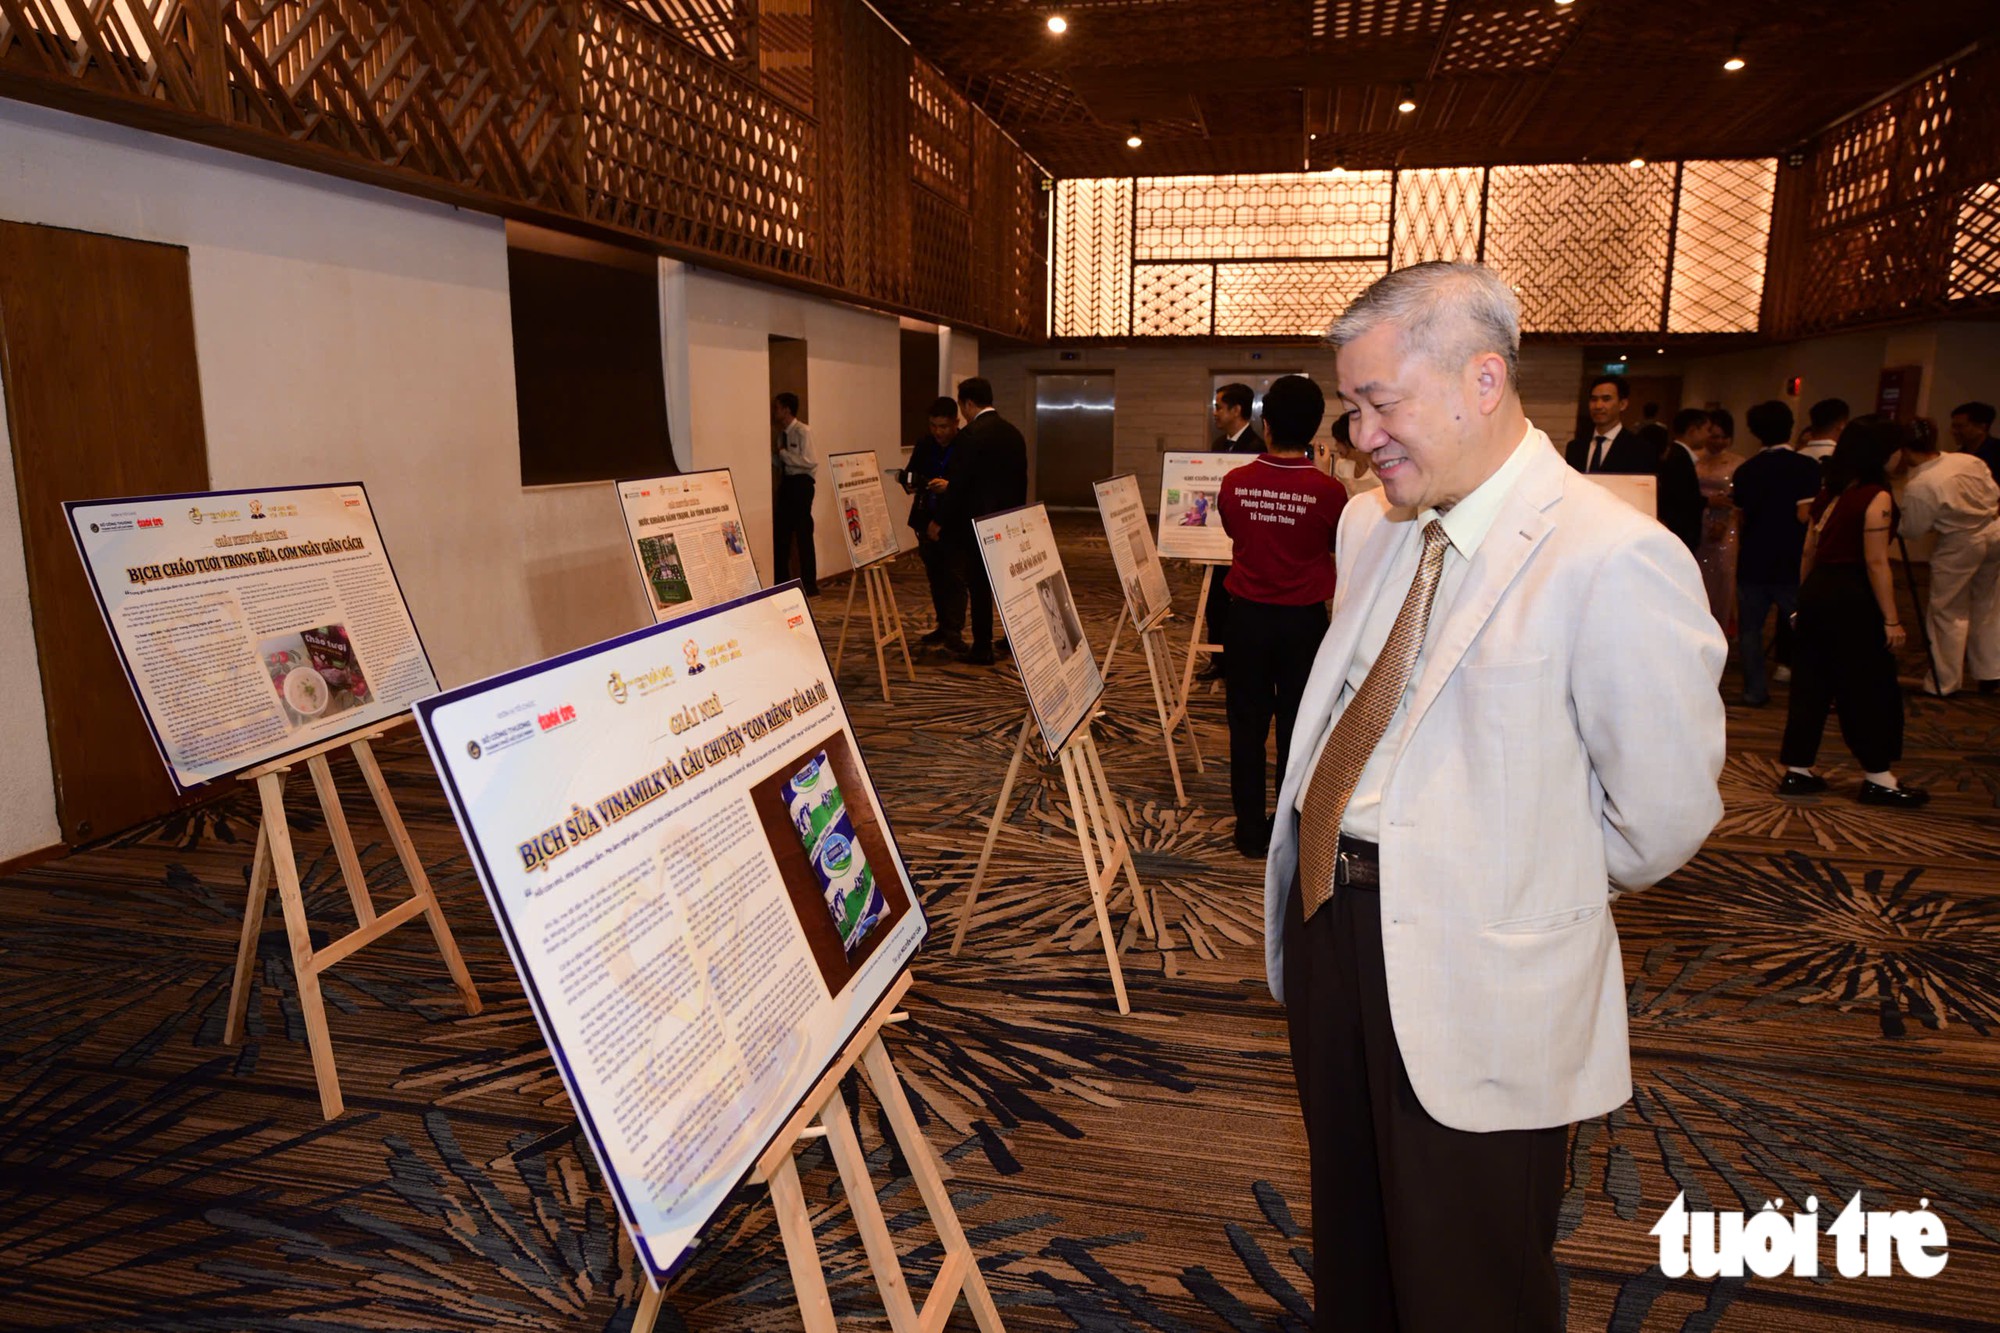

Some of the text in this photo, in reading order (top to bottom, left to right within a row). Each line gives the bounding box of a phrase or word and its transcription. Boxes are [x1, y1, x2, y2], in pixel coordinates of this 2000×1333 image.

[1235, 488, 1316, 504] Bệnh viện Nhân dân Gia Định
[1241, 499, 1306, 515] Phòng Công Tác Xã Hội
[1250, 511, 1295, 526] Tổ Truyền Thông
[127, 565, 163, 585] BỊCH
[162, 557, 196, 578] CHÁO
[195, 555, 222, 573] TƯƠI
[220, 551, 257, 570] TRONG
[256, 547, 279, 564] BỮA
[278, 545, 300, 560] CƠM
[298, 540, 322, 558] NGÀY
[321, 538, 344, 554] GIÃN
[342, 536, 365, 551] CÁCH
[669, 704, 700, 735] GIẢI
[518, 824, 568, 872] BỊCH
[565, 804, 602, 846] SỮA
[596, 770, 667, 826] VINAMILK
[664, 757, 684, 788] VÀ
[680, 746, 704, 779] CÂU
[703, 726, 746, 766] CHUYỆN
[792, 687, 810, 715] CỦA
[804, 689, 818, 710] BA
[814, 679, 829, 703] TÔI
